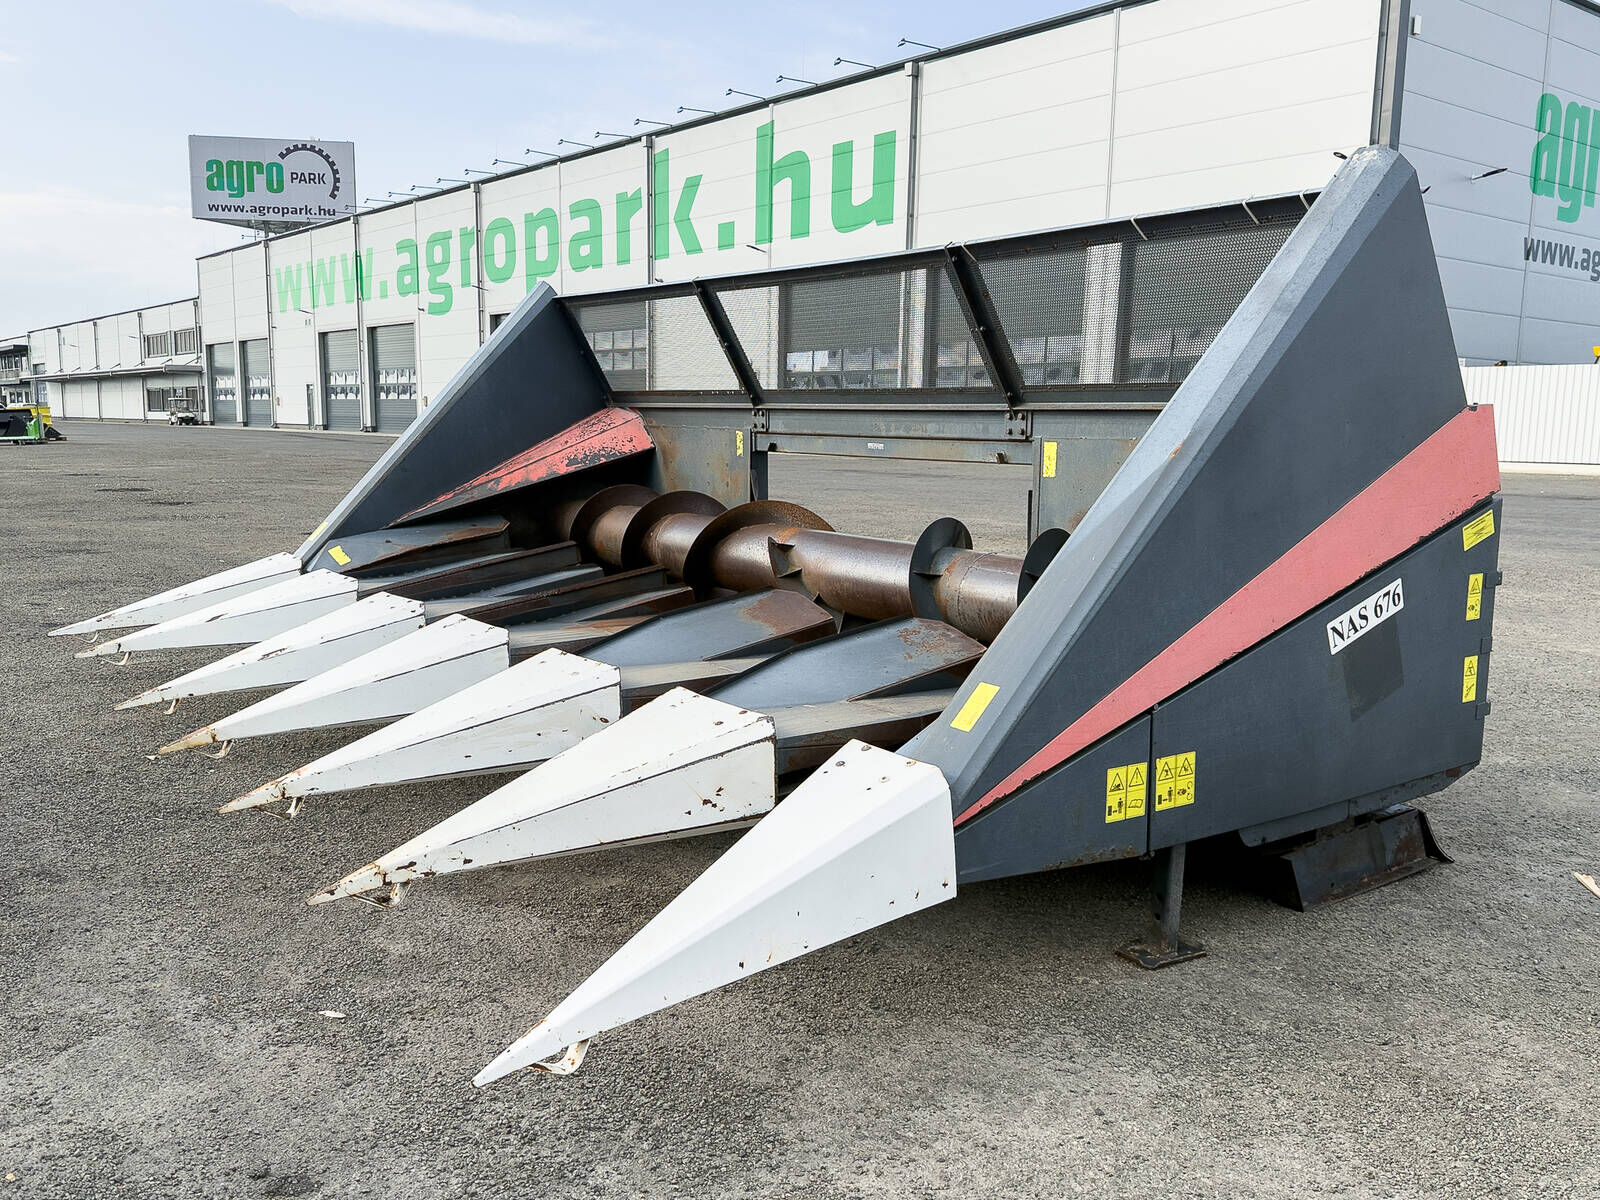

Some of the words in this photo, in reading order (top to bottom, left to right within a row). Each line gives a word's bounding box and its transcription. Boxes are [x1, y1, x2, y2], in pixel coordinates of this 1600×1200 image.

[205, 159, 285, 198] agro
[290, 171, 327, 185] PARK
[207, 203, 336, 217] www.agropark.hu
[275, 119, 897, 316] www.agropark.hu
[1523, 236, 1600, 281] www.ag
[1330, 605, 1369, 649] NAS
[1373, 583, 1401, 619] 676
